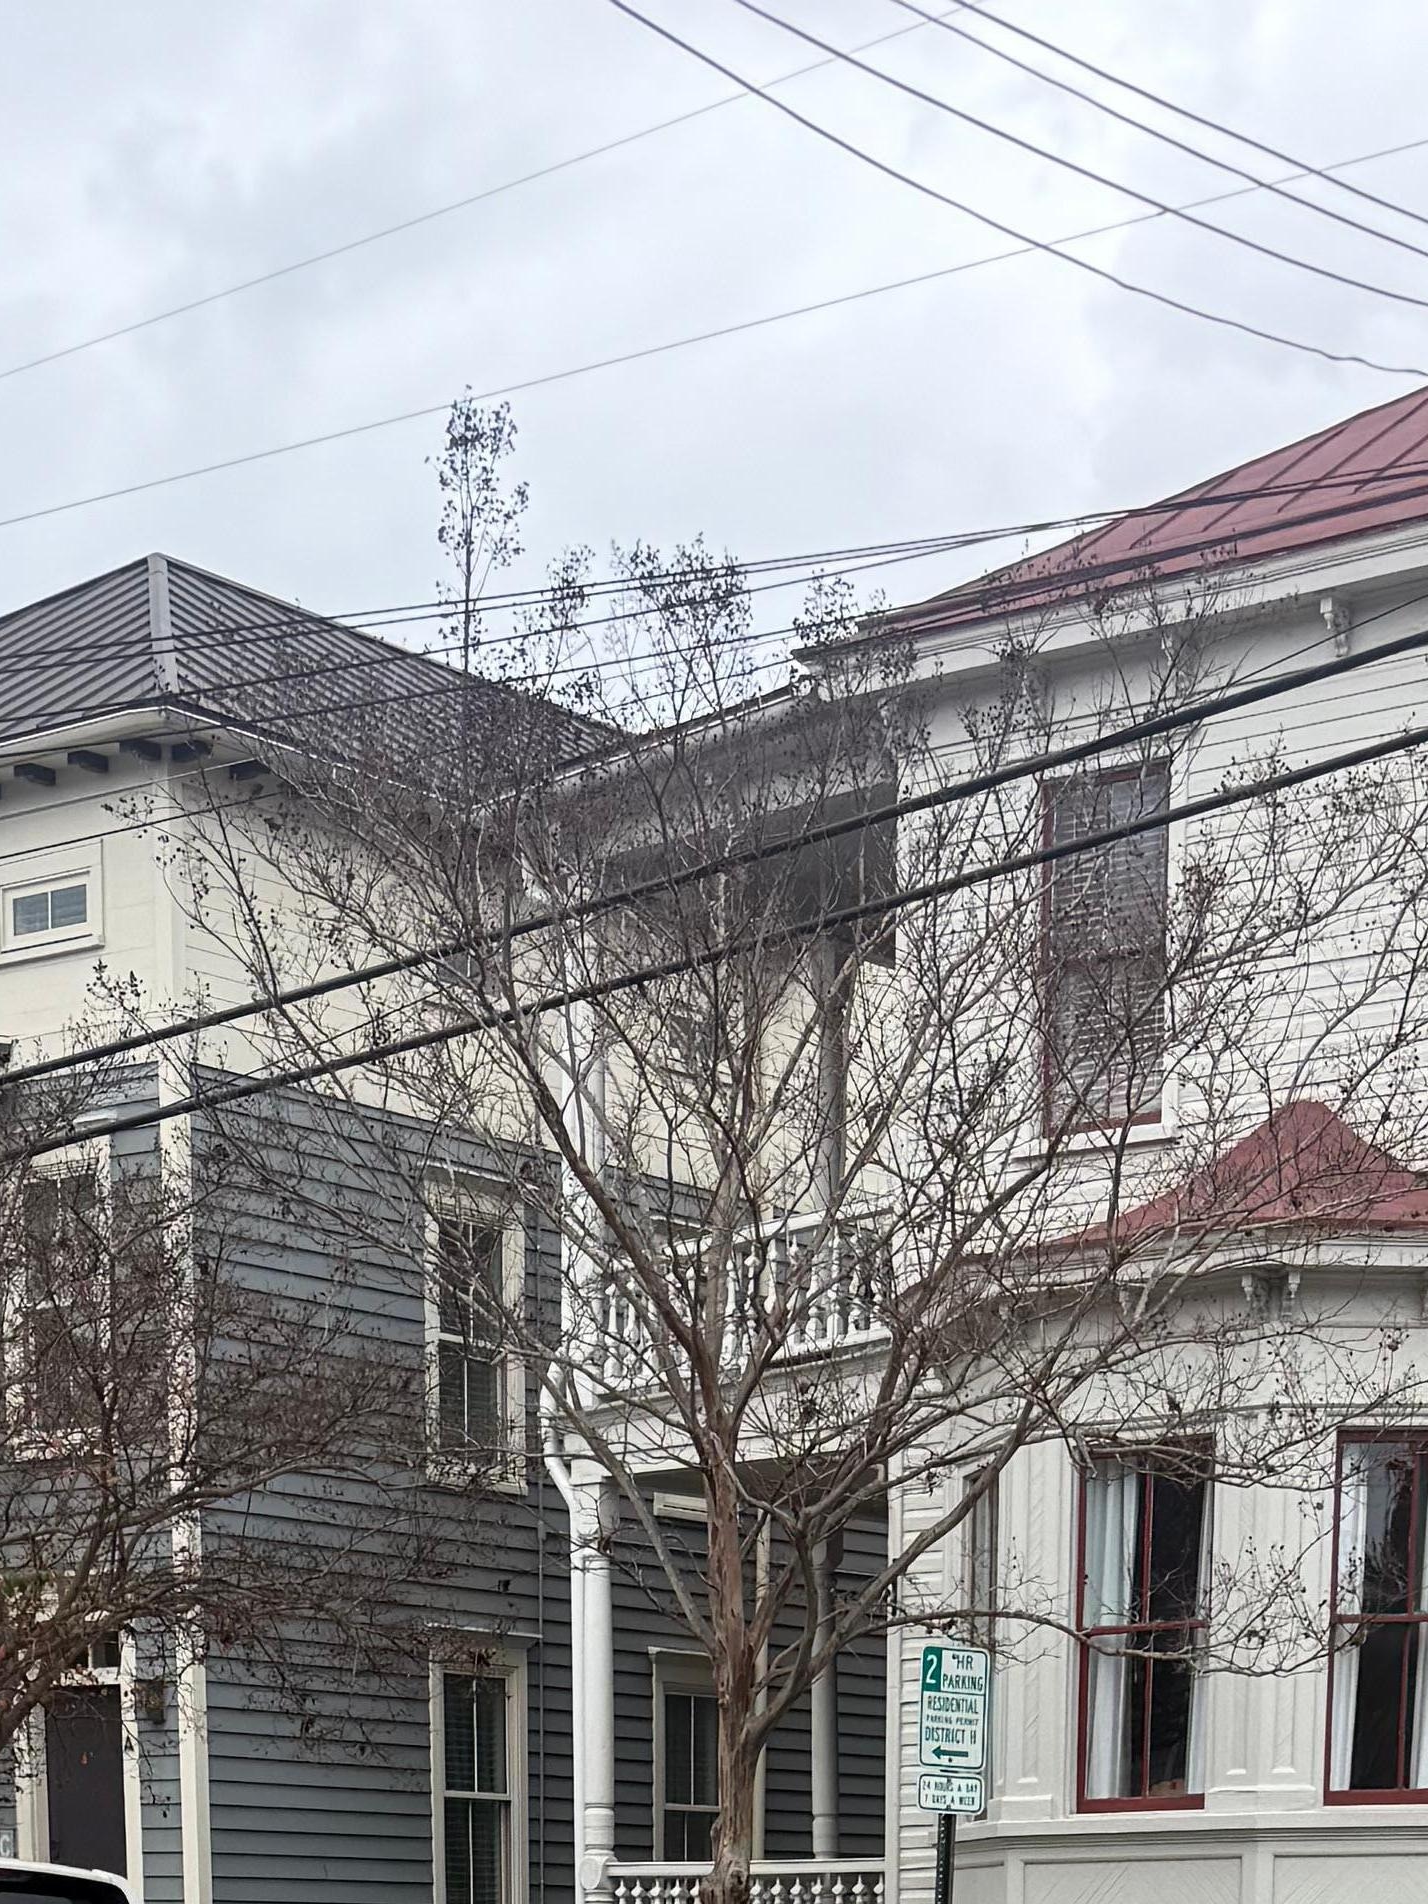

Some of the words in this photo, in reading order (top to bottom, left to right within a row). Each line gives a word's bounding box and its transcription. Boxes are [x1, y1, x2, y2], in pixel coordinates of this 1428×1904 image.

[925, 1654, 938, 1684] 2
[956, 1655, 974, 1670] HR
[942, 1674, 984, 1692] PARKING
[927, 1695, 979, 1715] RESIDENTIAL
[925, 1726, 965, 1744] DISTRICT
[970, 1729, 977, 1745] H
